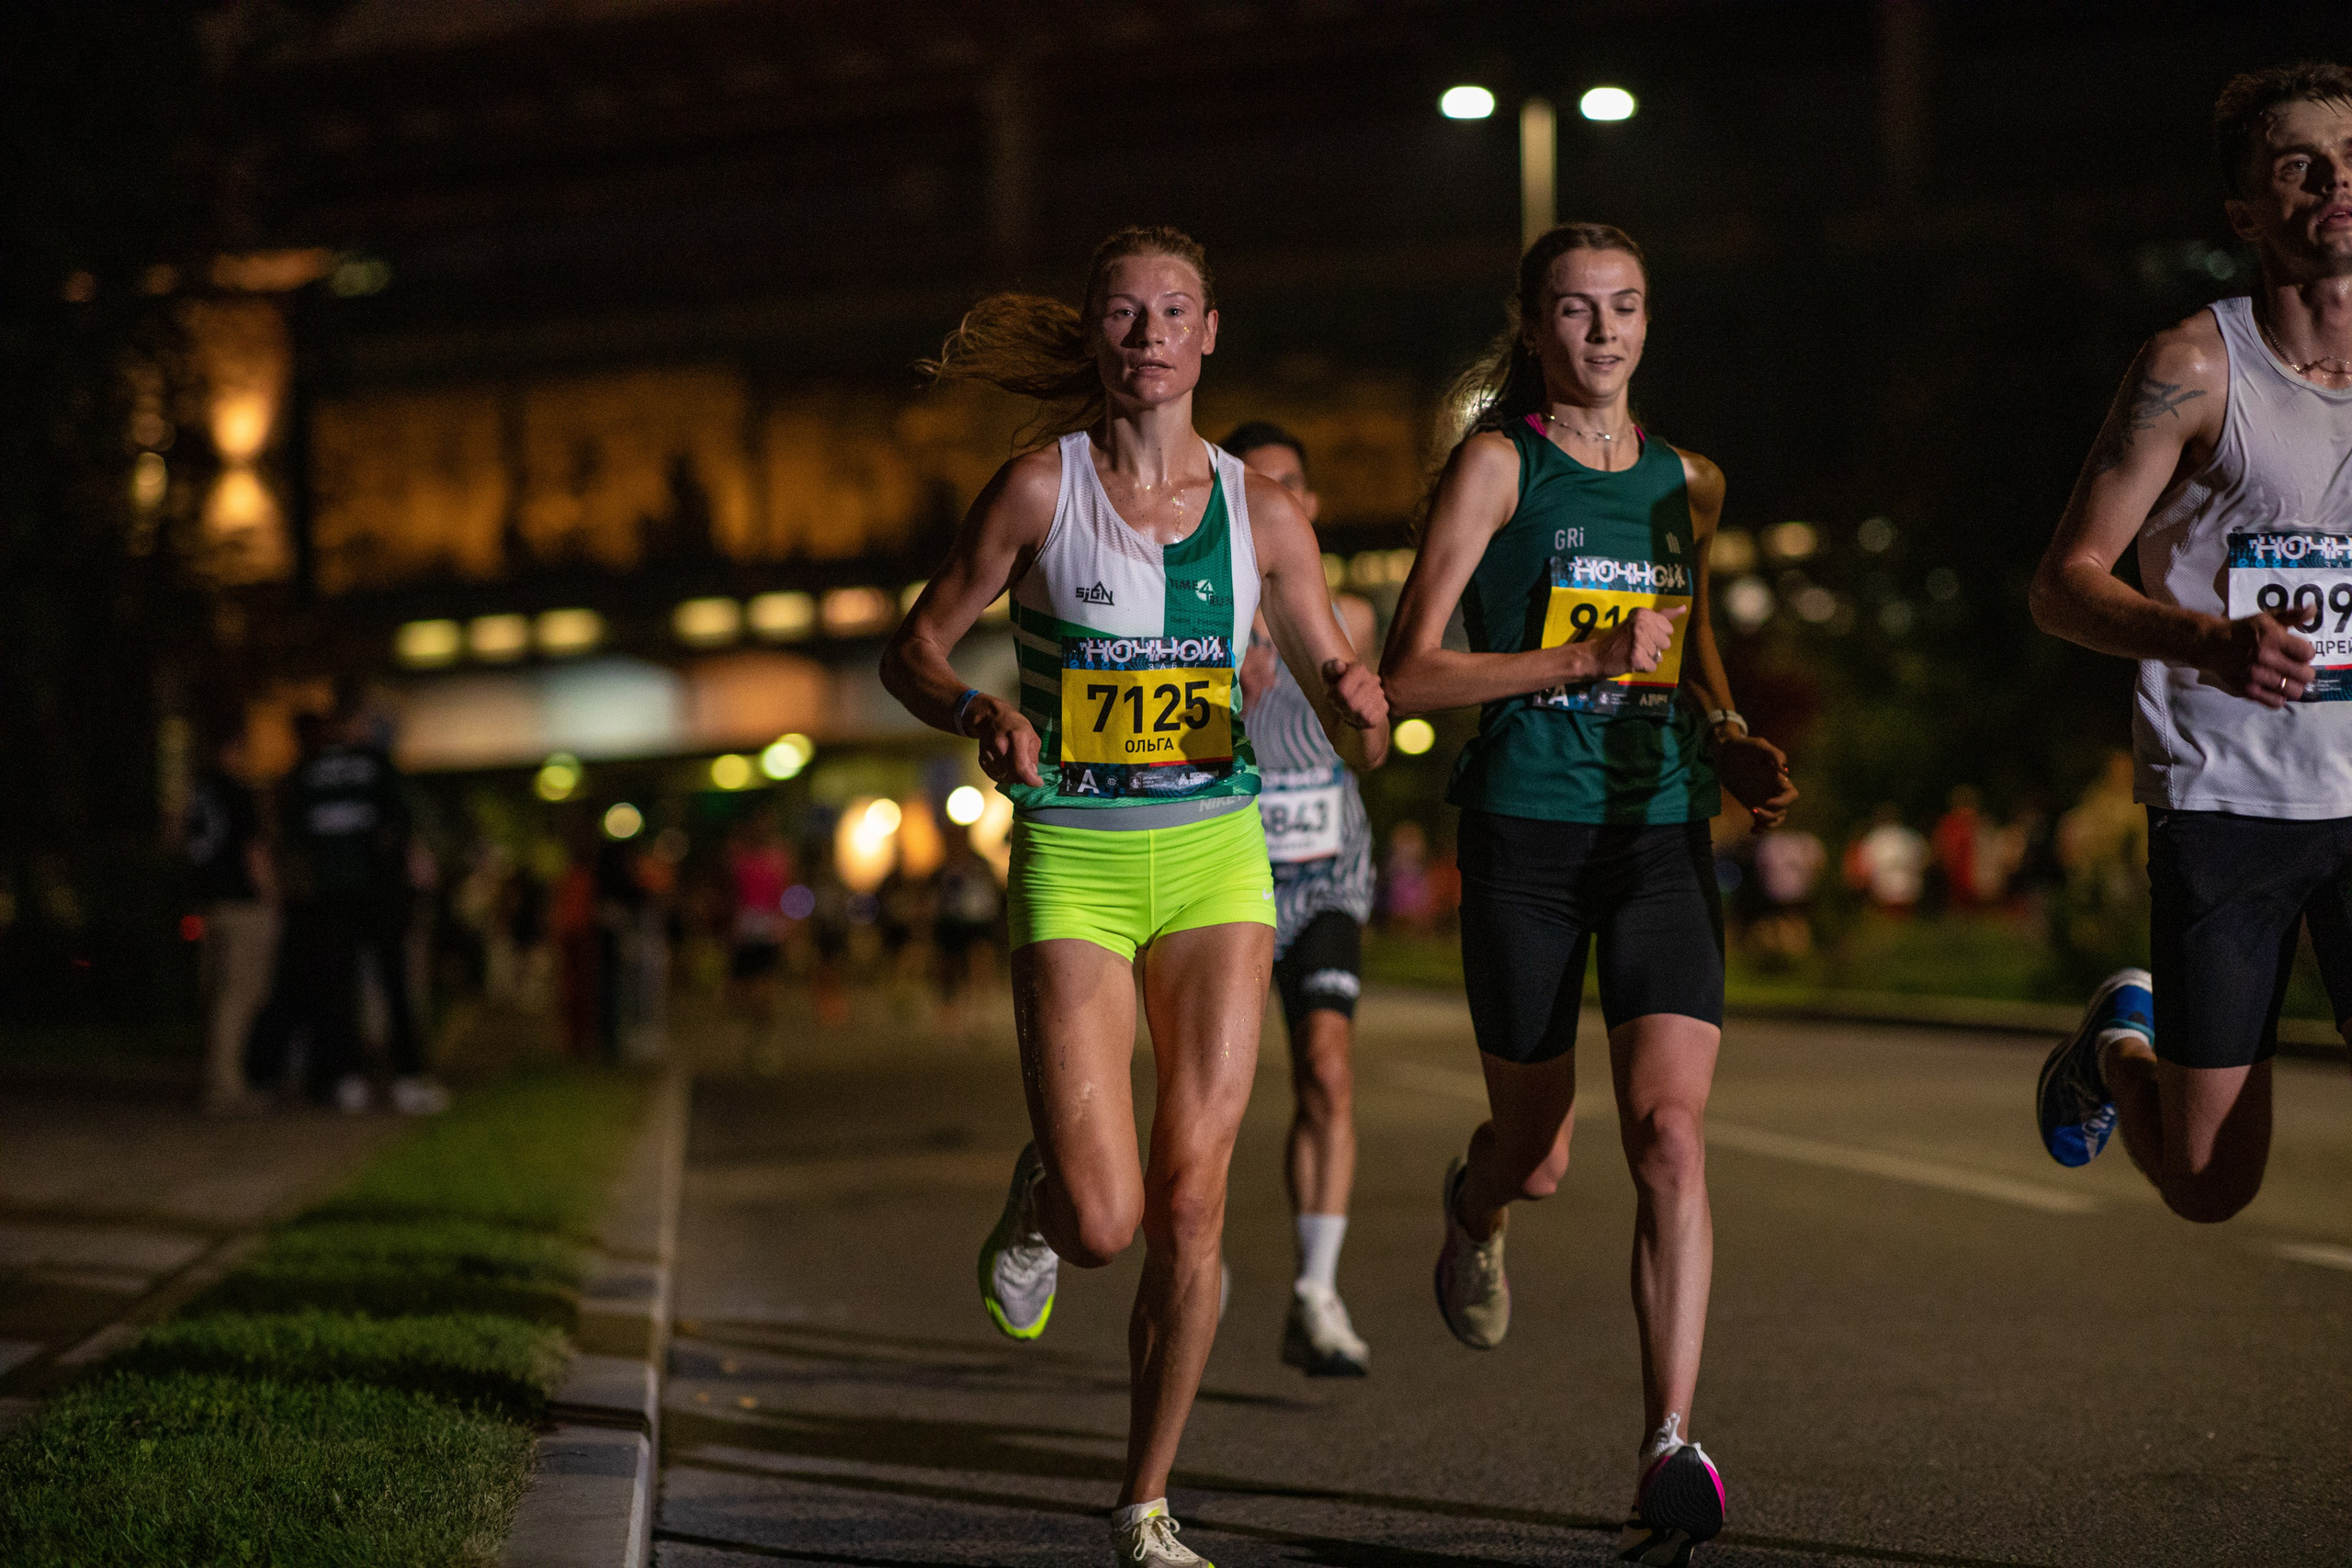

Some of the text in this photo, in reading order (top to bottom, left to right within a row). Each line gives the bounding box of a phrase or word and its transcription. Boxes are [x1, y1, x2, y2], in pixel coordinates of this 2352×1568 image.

[1080, 636, 1225, 662] НОЧНОЙ
[2309, 637, 2352, 658] ДРЕ
[1087, 681, 1211, 734] 7125
[1125, 738, 1174, 754] ОЛЬГА
